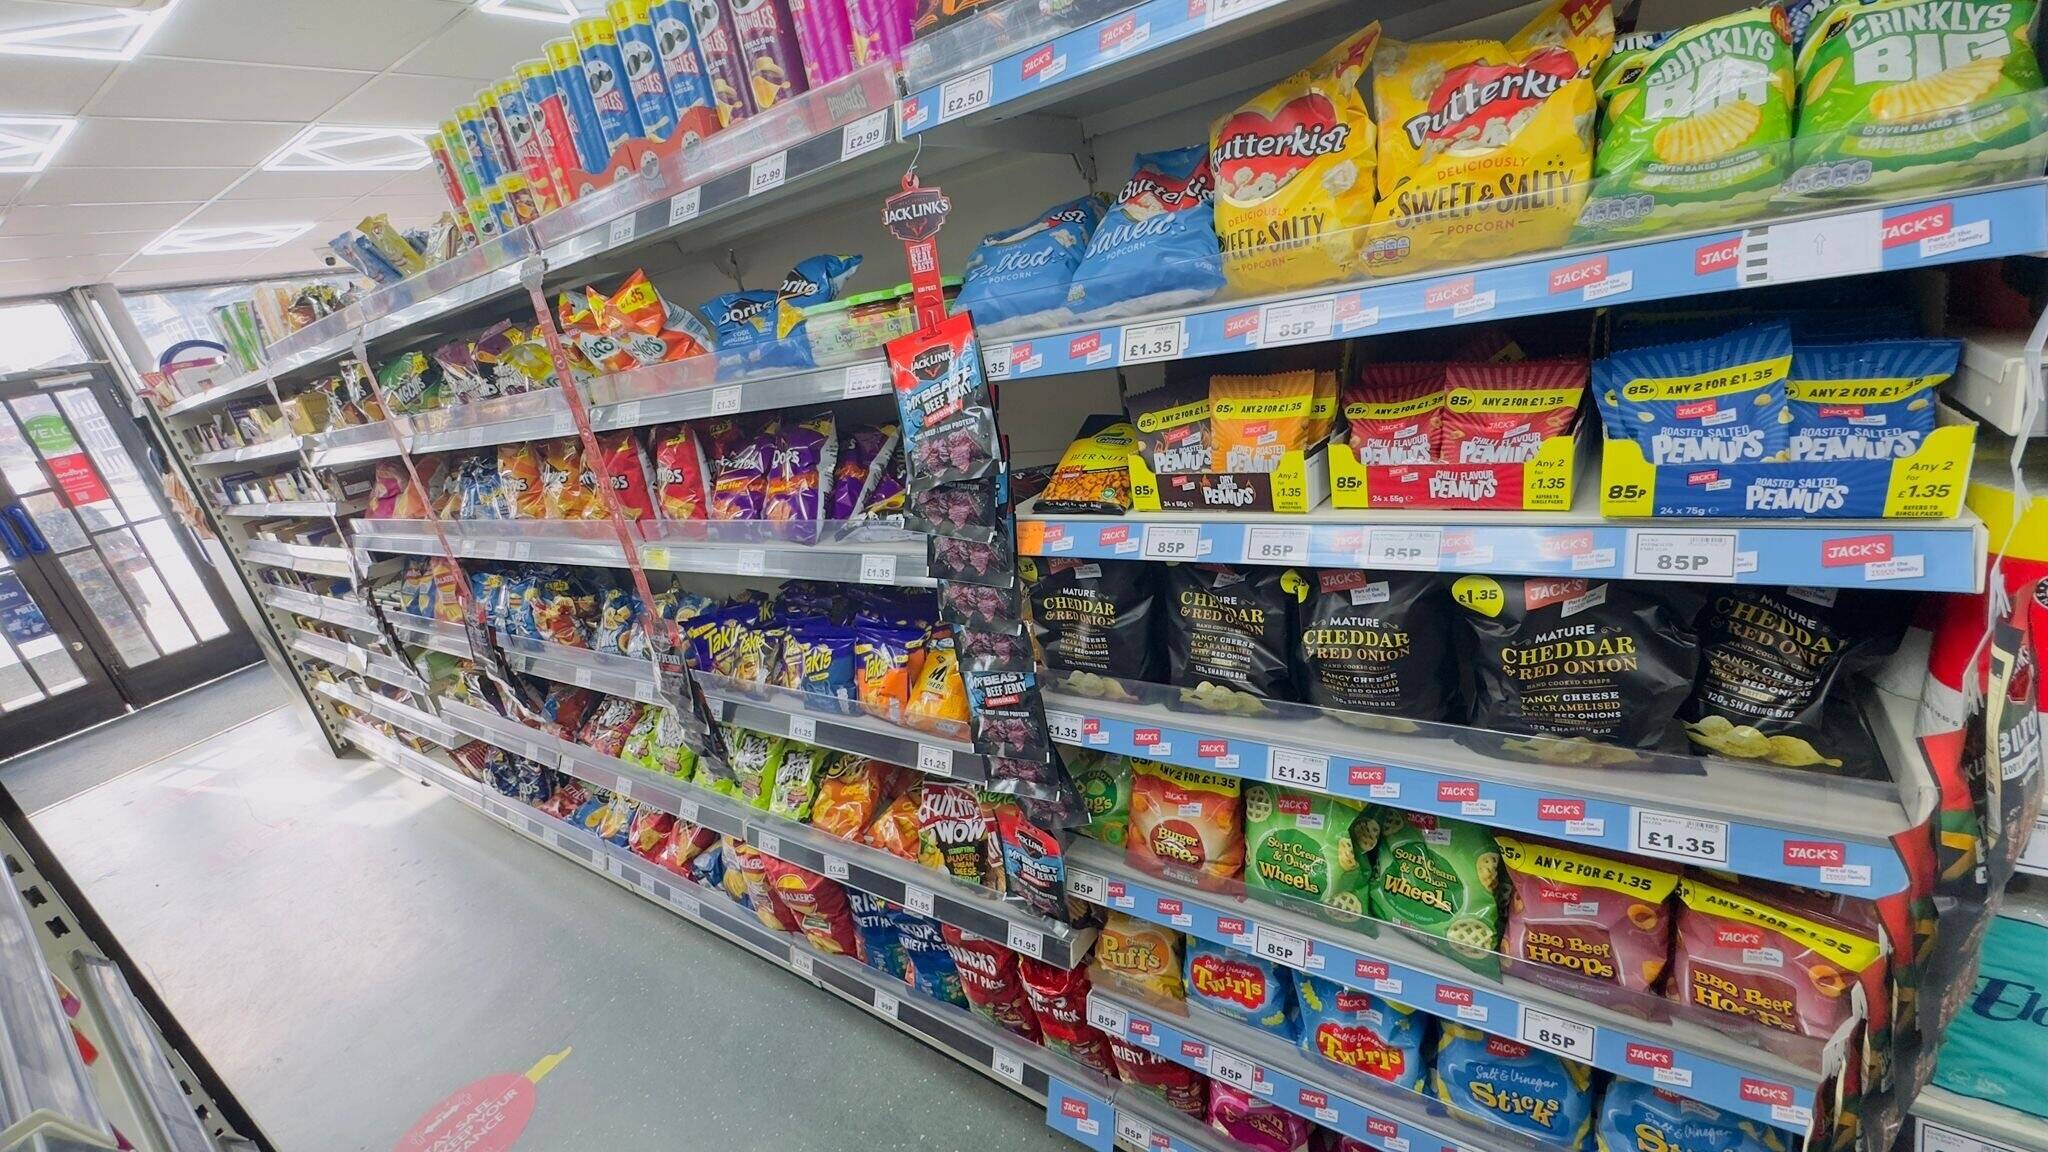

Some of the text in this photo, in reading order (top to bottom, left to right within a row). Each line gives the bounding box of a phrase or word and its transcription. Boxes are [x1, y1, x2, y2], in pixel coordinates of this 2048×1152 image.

[1101, 19, 1134, 43] JACK'S
[1845, 1, 2011, 49] CRINKLYS
[1646, 27, 1776, 88] CRINKLYS
[1852, 29, 2010, 85] BIG
[947, 89, 984, 113] £2.50
[849, 129, 880, 150] £2.99
[755, 168, 781, 186] £2.99
[1437, 157, 1529, 181] DELICIOUSLY
[1396, 169, 1575, 228] SWEET & SALTY
[671, 202, 696, 221] £2.99
[883, 199, 949, 226] JACK LINK'S
[1228, 207, 1289, 228] DELICIOUSLY
[1088, 212, 1172, 259] Salted
[1447, 219, 1515, 236] POPCORN
[1106, 241, 1146, 261] POPCORN
[968, 246, 1054, 281] Salted
[1241, 256, 1286, 273] POPCORN
[988, 271, 1033, 285] POPCORN
[1553, 263, 1602, 287] JACK'S
[1130, 340, 1172, 358] £1.35
[1808, 377, 1924, 398] ANY 2 FOR £1.35
[924, 395, 946, 415] BEEF
[1241, 404, 1256, 413] ANY
[1257, 404, 1263, 413] 2
[1263, 403, 1278, 413] FOR
[1279, 402, 1302, 412] £1.35
[1450, 396, 1563, 407] 85p ANY 2 FOR £1.35
[1660, 424, 1750, 438] ROASTED SALTED
[1800, 426, 1903, 438] ROASTED SALTED
[1232, 444, 1286, 454] HONEY ROASTED
[1651, 430, 1765, 464] PEANUTS
[1790, 430, 1921, 462] PEANUTS
[1536, 459, 1565, 469] Any 2
[1908, 461, 1954, 473] Any 2
[56, 467, 89, 480] oodbye
[1435, 470, 1494, 480] CHILLI FLAVOUR
[1754, 476, 1838, 489] ROASTED SALTED
[1135, 486, 1154, 496] 85p
[1336, 477, 1362, 489] 85p
[1428, 478, 1498, 502] PEANUTS
[1607, 484, 1647, 499] 85p
[1897, 484, 1952, 499] £1.35
[1745, 484, 1850, 513] PEANUTS
[1660, 506, 1706, 516] 24 x 75g
[1157, 541, 1185, 554] 85P
[1261, 544, 1294, 556] 85P
[1384, 547, 1422, 560] 85P
[1657, 554, 1710, 570] 85P
[868, 568, 890, 578] £1.35
[1062, 588, 1096, 598] MATURE
[1458, 589, 1498, 604] £1.35
[1043, 597, 1116, 616] CHEDDAR
[1760, 594, 1818, 630] MATURE
[1329, 616, 1380, 628] MATURE
[1192, 633, 1256, 648] TANGY CHEESE
[1302, 629, 1410, 648] CHEDDAR
[1534, 624, 1596, 644] MATURE
[1211, 651, 1251, 663] RED ONIONS
[1501, 636, 1637, 666] CHEDDAR
[1321, 670, 1398, 684] TANGY CHEESE
[986, 680, 1027, 698] BEEF JERKY
[1521, 691, 1620, 704] TANGY CHEESE
[1531, 702, 1621, 712] CARAMELISED
[1707, 692, 1796, 719] 120g SHARING BAG
[1577, 711, 1622, 720] ONIONS
[1135, 732, 1158, 742] JACK'S
[1200, 743, 1225, 753] JACK'S
[923, 757, 947, 770] £1.25
[1278, 765, 1321, 784] £1.35
[1440, 785, 1475, 798] JACK'S
[935, 820, 987, 844] WOW
[1157, 827, 1200, 849] Burger
[1647, 830, 1717, 856] £1.35
[1787, 846, 1840, 861] JACK'S
[1258, 861, 1320, 896] Wheels
[1534, 854, 1653, 891] ANY 2 FOR £1.35
[1073, 881, 1093, 894] 85P
[1383, 874, 1453, 913] Wheels
[910, 897, 930, 912] £1.95
[1013, 936, 1037, 952] £1.95
[1100, 932, 1161, 972] Puffs
[1267, 943, 1294, 960] 85P
[1527, 930, 1611, 959] BBQ Beef
[1526, 943, 1614, 978] Hoops
[1192, 964, 1263, 1007] Twirls
[1693, 969, 1794, 1016] BBQ Beef
[1053, 1009, 1080, 1023] PACK
[1098, 1013, 1117, 1028] 85P
[1538, 1028, 1576, 1050] 85P
[1318, 1031, 1402, 1073] Twirls
[1629, 1047, 1670, 1064] JACK'S
[1000, 1064, 1015, 1076] 99P
[1220, 1065, 1243, 1081] 85P
[1475, 1064, 1560, 1093] Salt & Vinegar
[1743, 1083, 1789, 1101] JACK'S
[475, 1088, 519, 1124] YOUR
[1468, 1079, 1561, 1129] Sticks
[455, 1097, 494, 1130] SAFE
[1124, 1126, 1143, 1141] 85P
